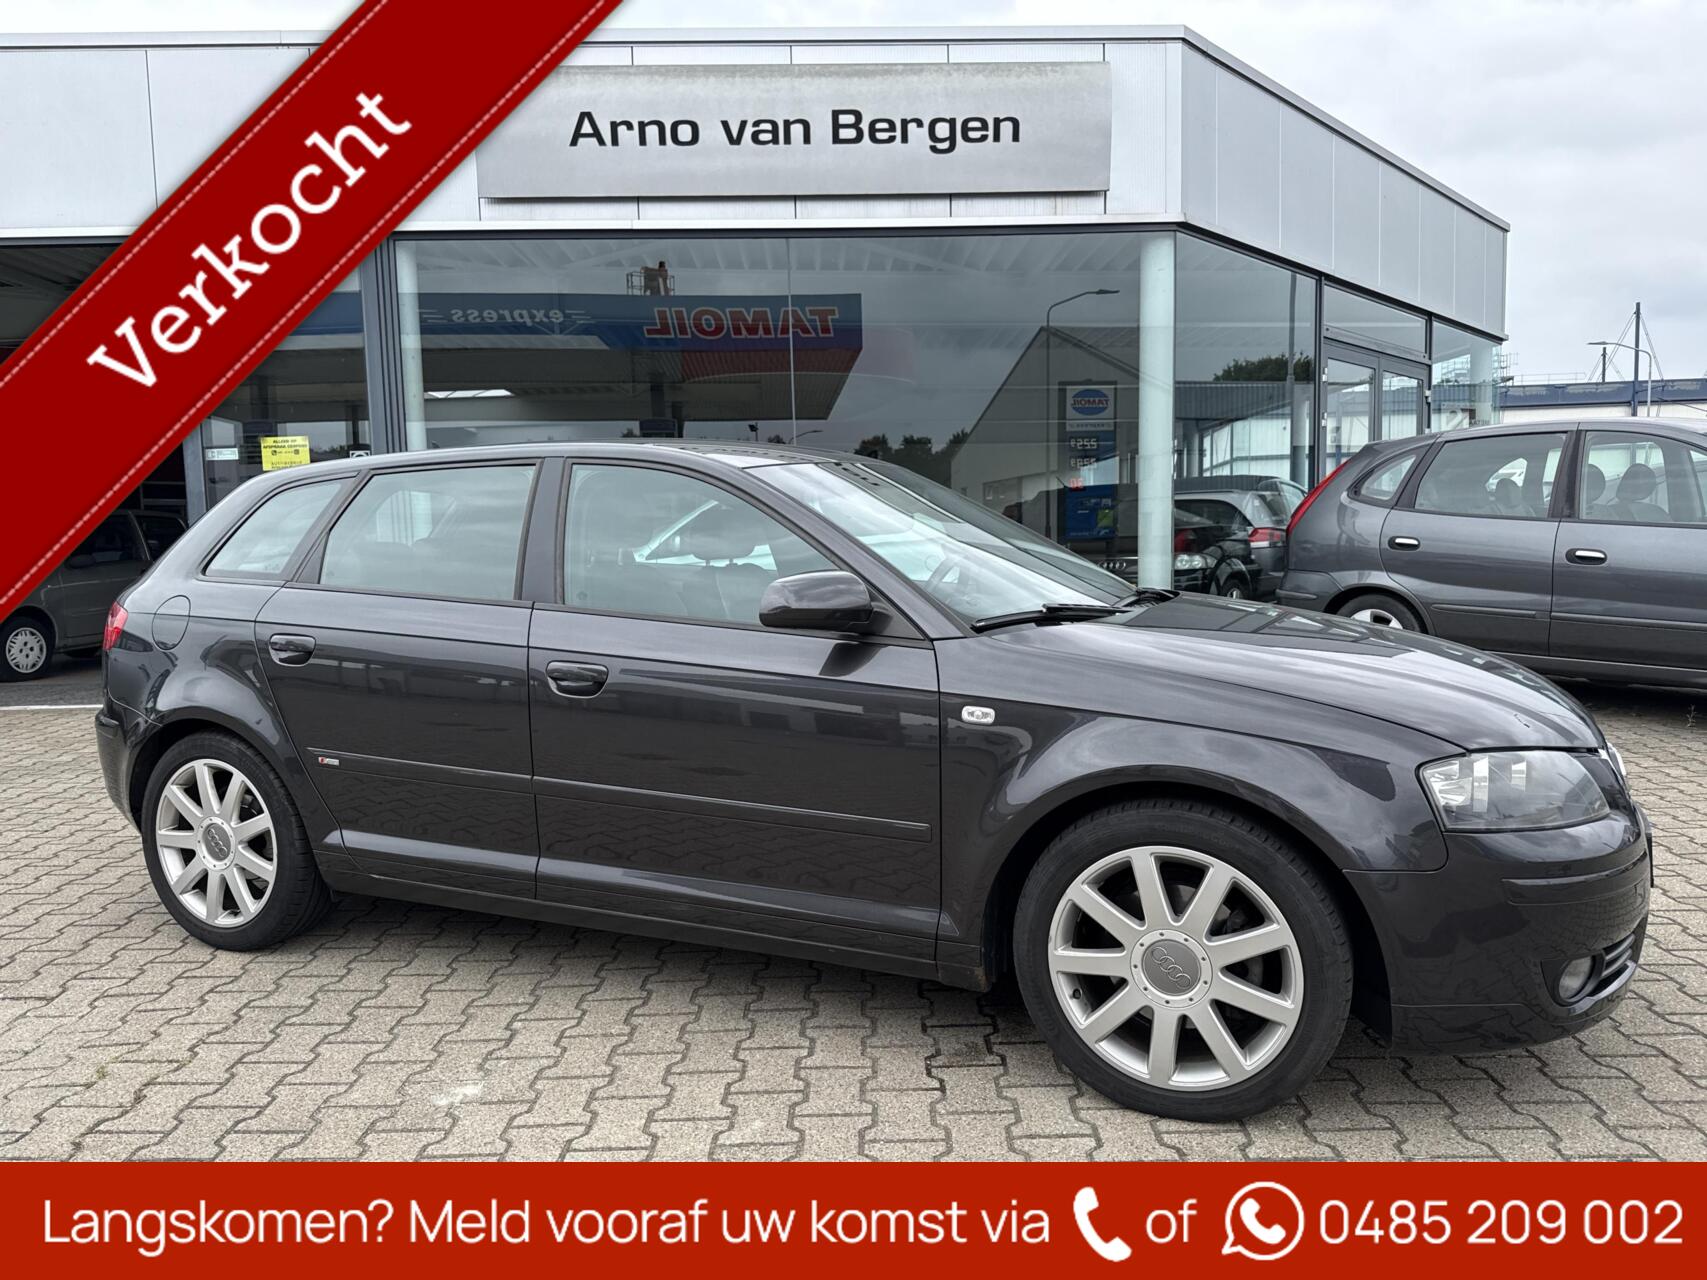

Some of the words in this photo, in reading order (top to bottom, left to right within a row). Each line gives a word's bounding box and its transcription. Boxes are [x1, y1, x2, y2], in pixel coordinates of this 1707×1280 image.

[569, 111, 700, 147] Arno
[720, 117, 811, 146] van
[831, 109, 1020, 154] Bergen
